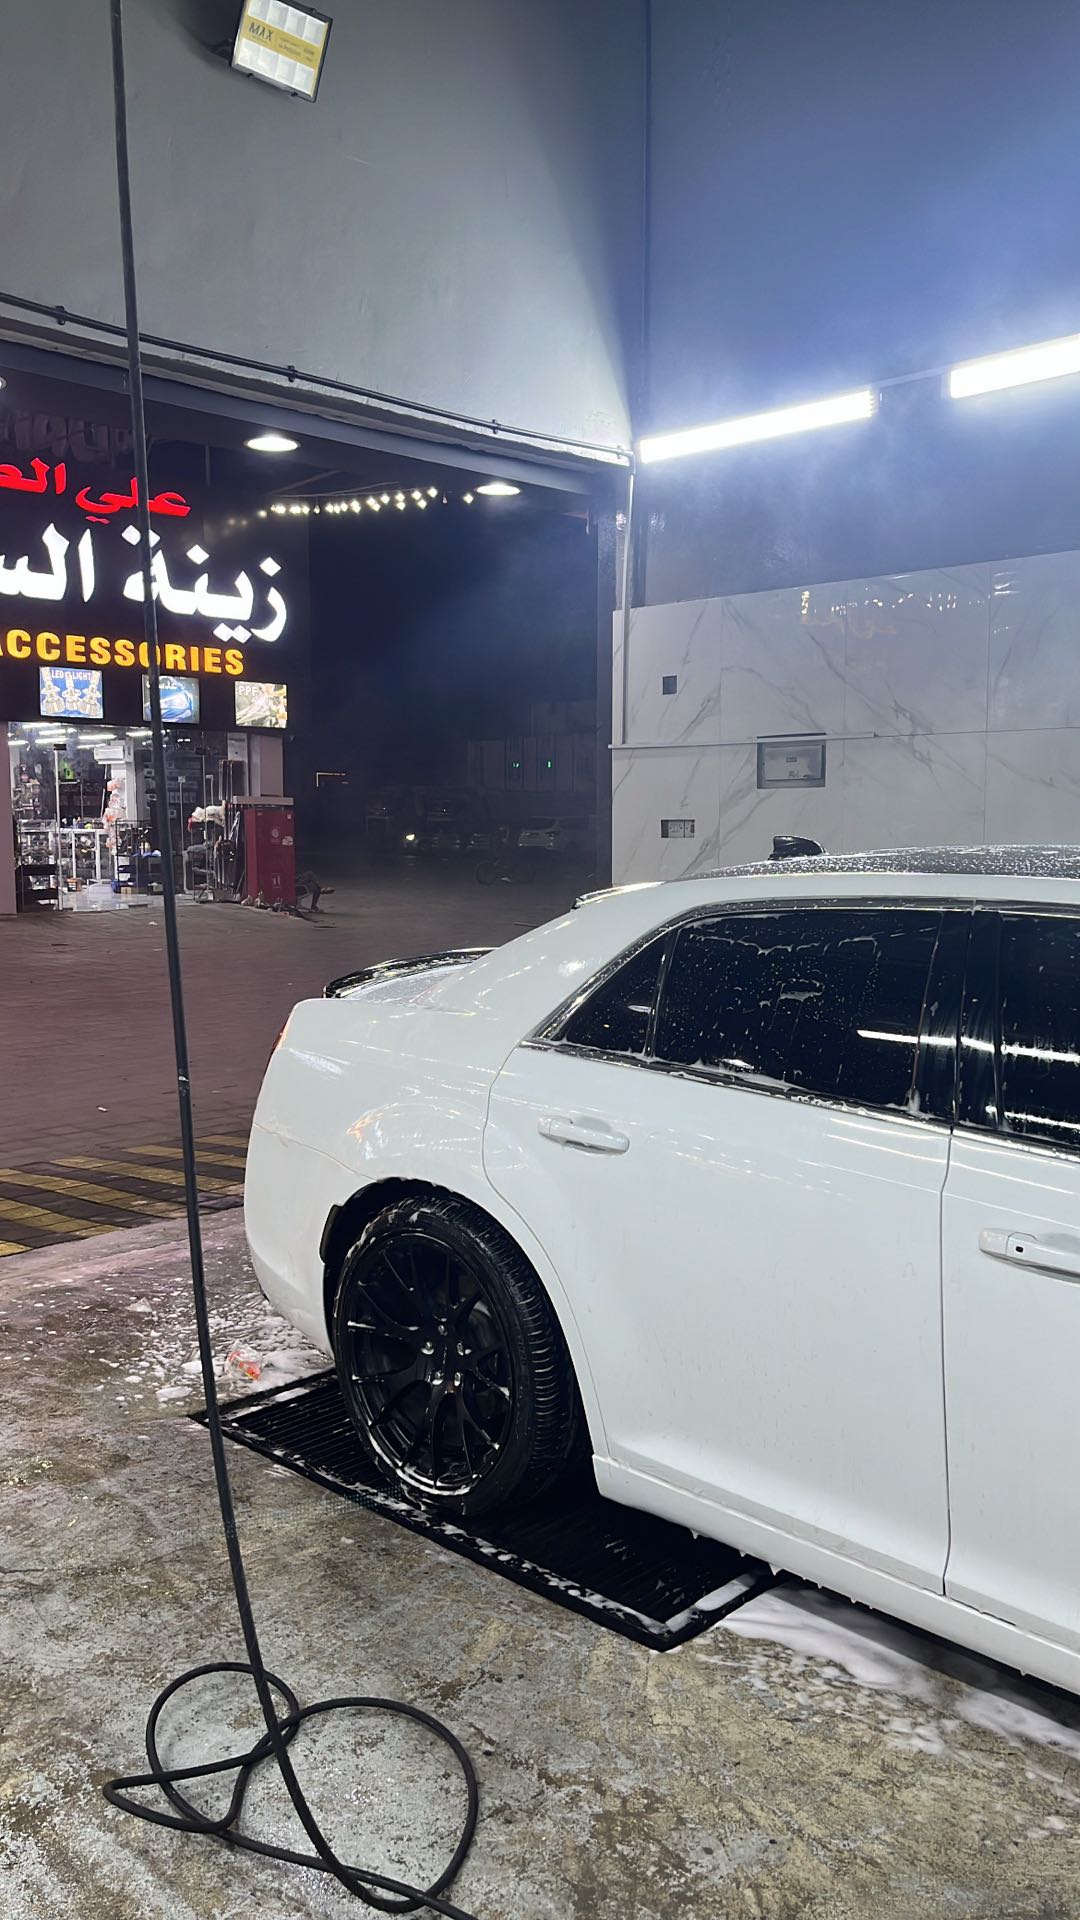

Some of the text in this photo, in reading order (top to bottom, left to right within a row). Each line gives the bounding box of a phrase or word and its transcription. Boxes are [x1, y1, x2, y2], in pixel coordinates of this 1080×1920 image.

[248, 21, 274, 41] MAX
[75, 476, 191, 525] علي
[121, 524, 287, 643] زينة
[0, 629, 244, 675] CCESSORIES
[51, 669, 92, 681] LED LIGHT
[238, 685, 259, 697] PPF
